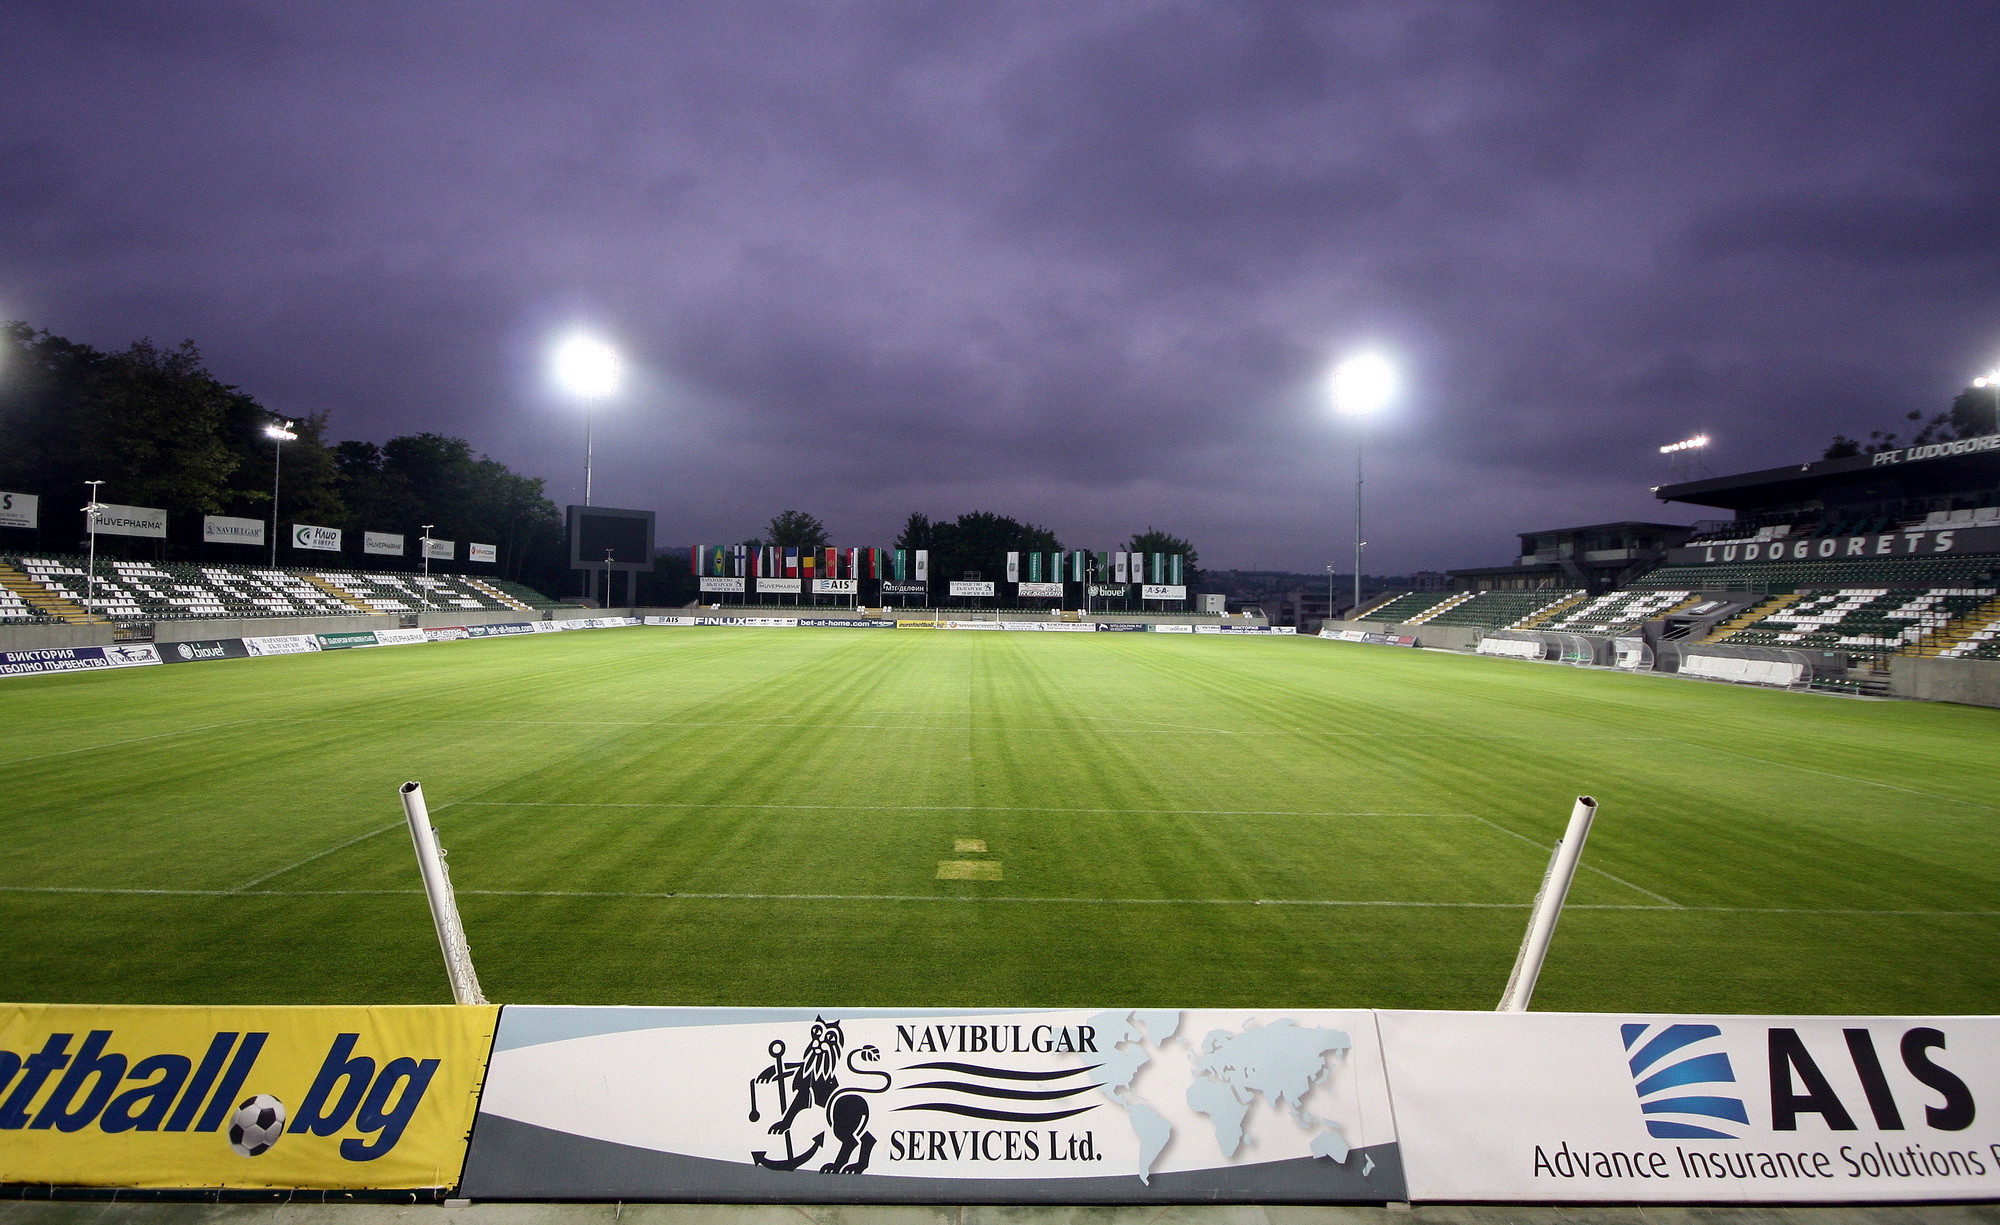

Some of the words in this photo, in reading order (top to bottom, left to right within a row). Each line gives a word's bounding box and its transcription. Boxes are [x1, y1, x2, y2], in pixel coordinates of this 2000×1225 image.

[1872, 450, 1903, 466] PFC
[1705, 531, 1954, 563] LUDOGORETS
[831, 580, 850, 590] AIS
[1099, 587, 1126, 597] biovet
[695, 617, 746, 626] FINLUX
[800, 619, 870, 627] bet-at-home.com
[427, 629, 464, 639] REACTOR
[486, 624, 534, 635] bet-at-home.com
[6, 649, 75, 662] ВИКТОРИЯ
[192, 642, 226, 658] biovet
[43, 657, 108, 671] ПЪРВЕНСТВО
[894, 1025, 1099, 1053] NAVIBULGAR
[0, 1030, 269, 1133] tball
[1767, 1027, 1976, 1131] AIS
[889, 1130, 1039, 1162] SERVICES
[1056, 1130, 1103, 1162] Ltd.
[1533, 1141, 1670, 1179] Advance
[1676, 1146, 1834, 1179] Insurance
[1847, 1141, 1987, 1178] Solutions
